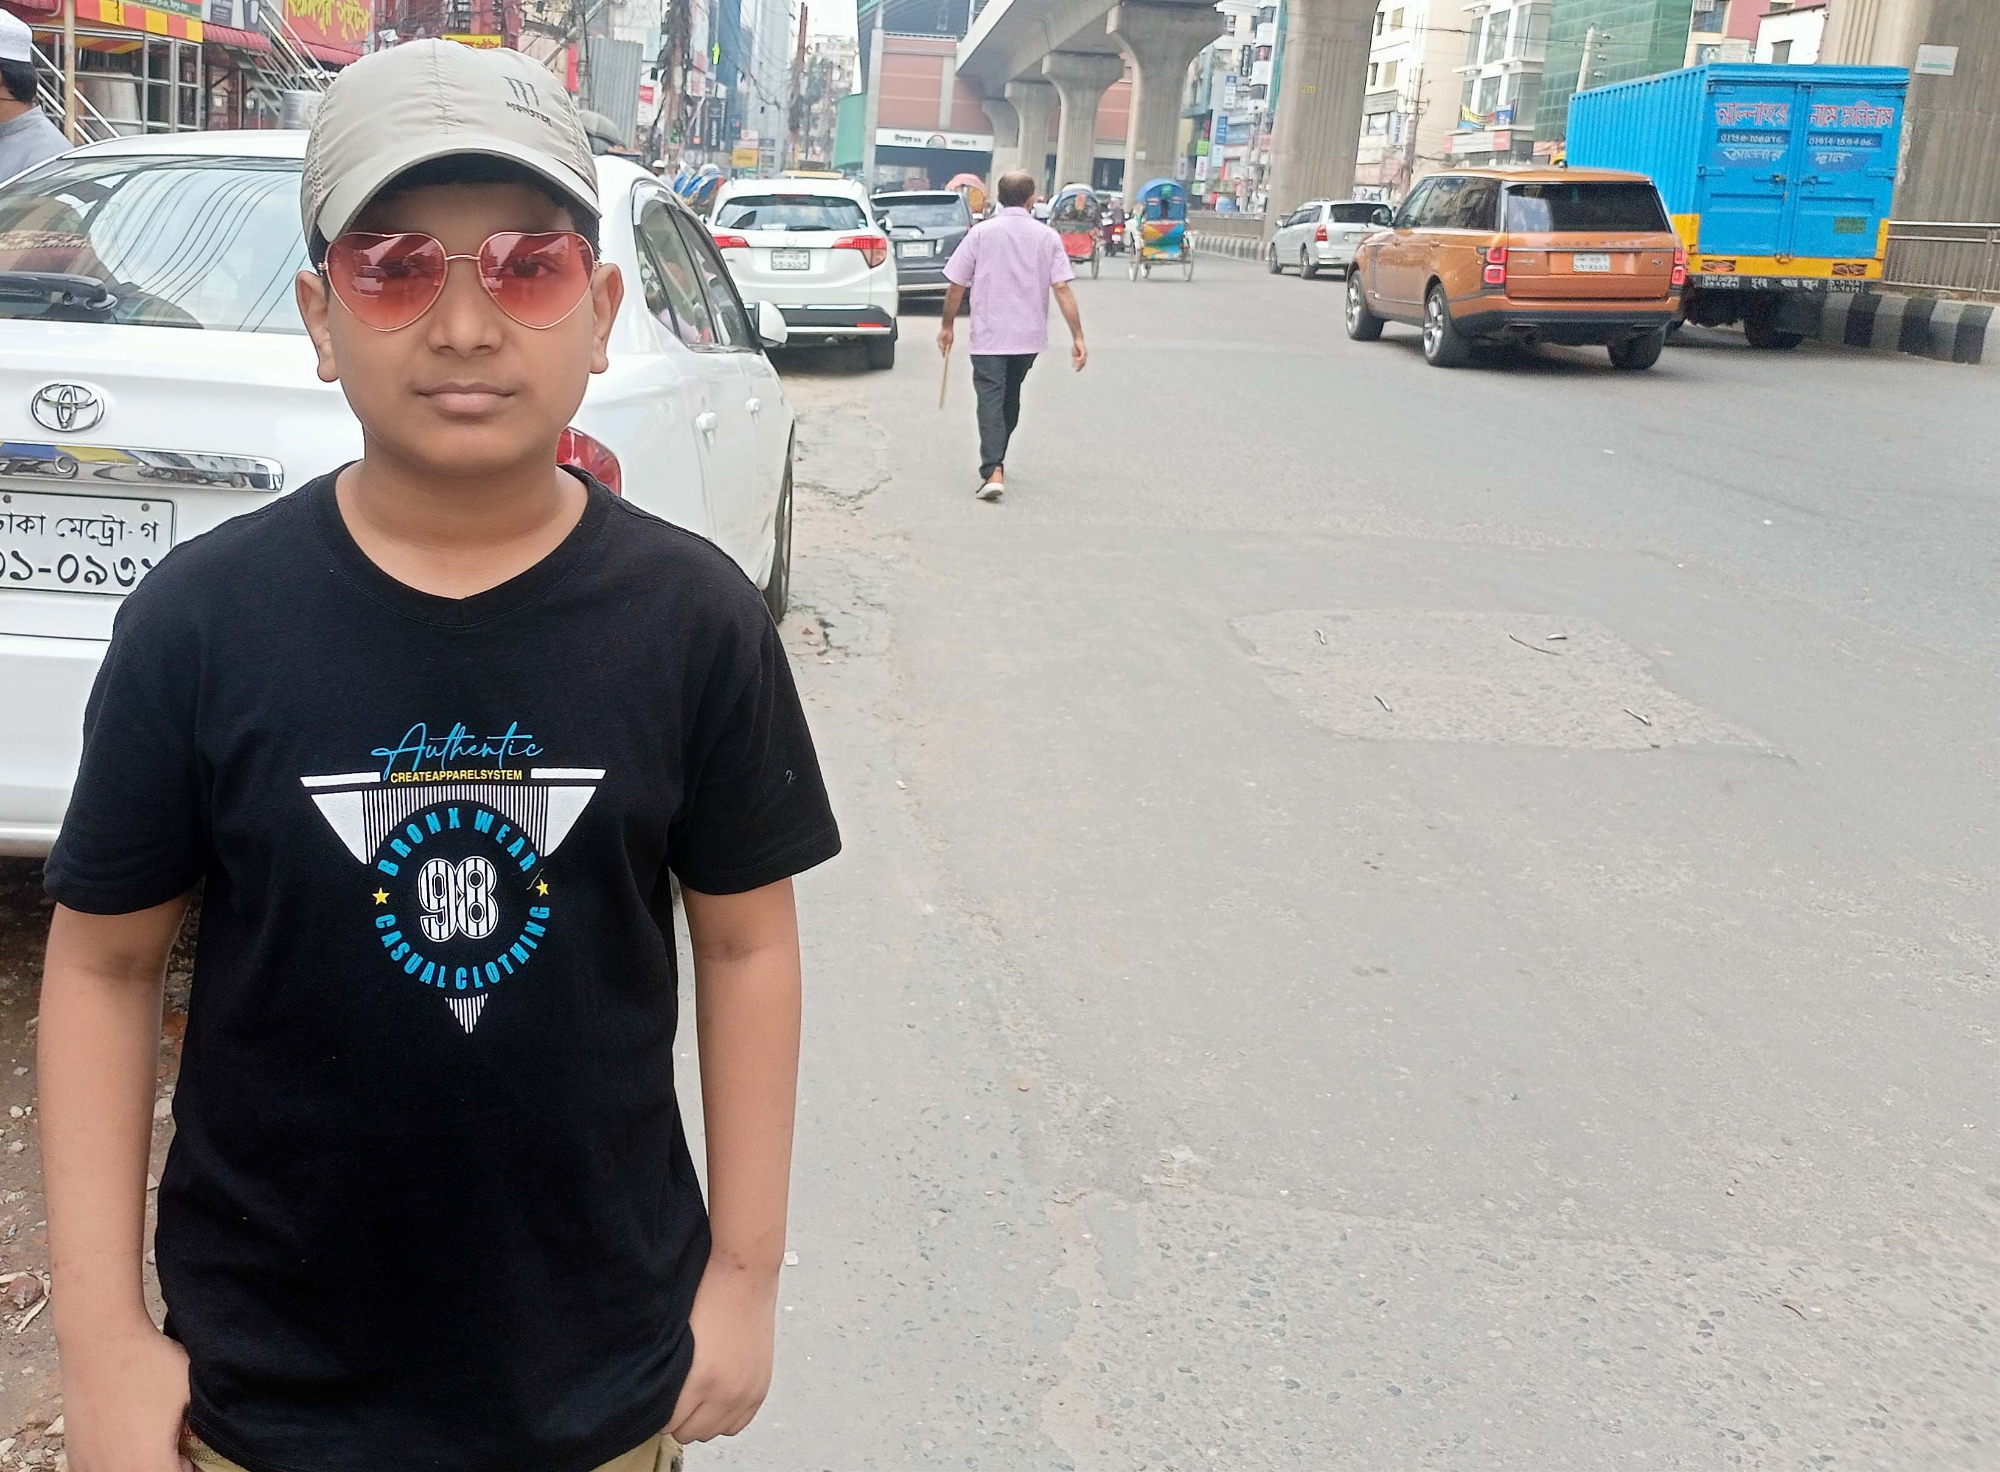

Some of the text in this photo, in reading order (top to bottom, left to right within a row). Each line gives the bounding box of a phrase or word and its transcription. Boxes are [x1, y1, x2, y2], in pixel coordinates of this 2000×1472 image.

[1714, 102, 1789, 127] আল্লাহর
[1841, 100, 1895, 128] চলিলাম
[0, 550, 154, 587] ১-০৯৩
[371, 721, 544, 781] Authentic
[390, 769, 523, 784] CREATEAPPARELSYSTEM
[378, 807, 536, 876] BRONX WEAR
[417, 856, 499, 942] 98
[375, 906, 550, 990] CASUAL CLOTHING
